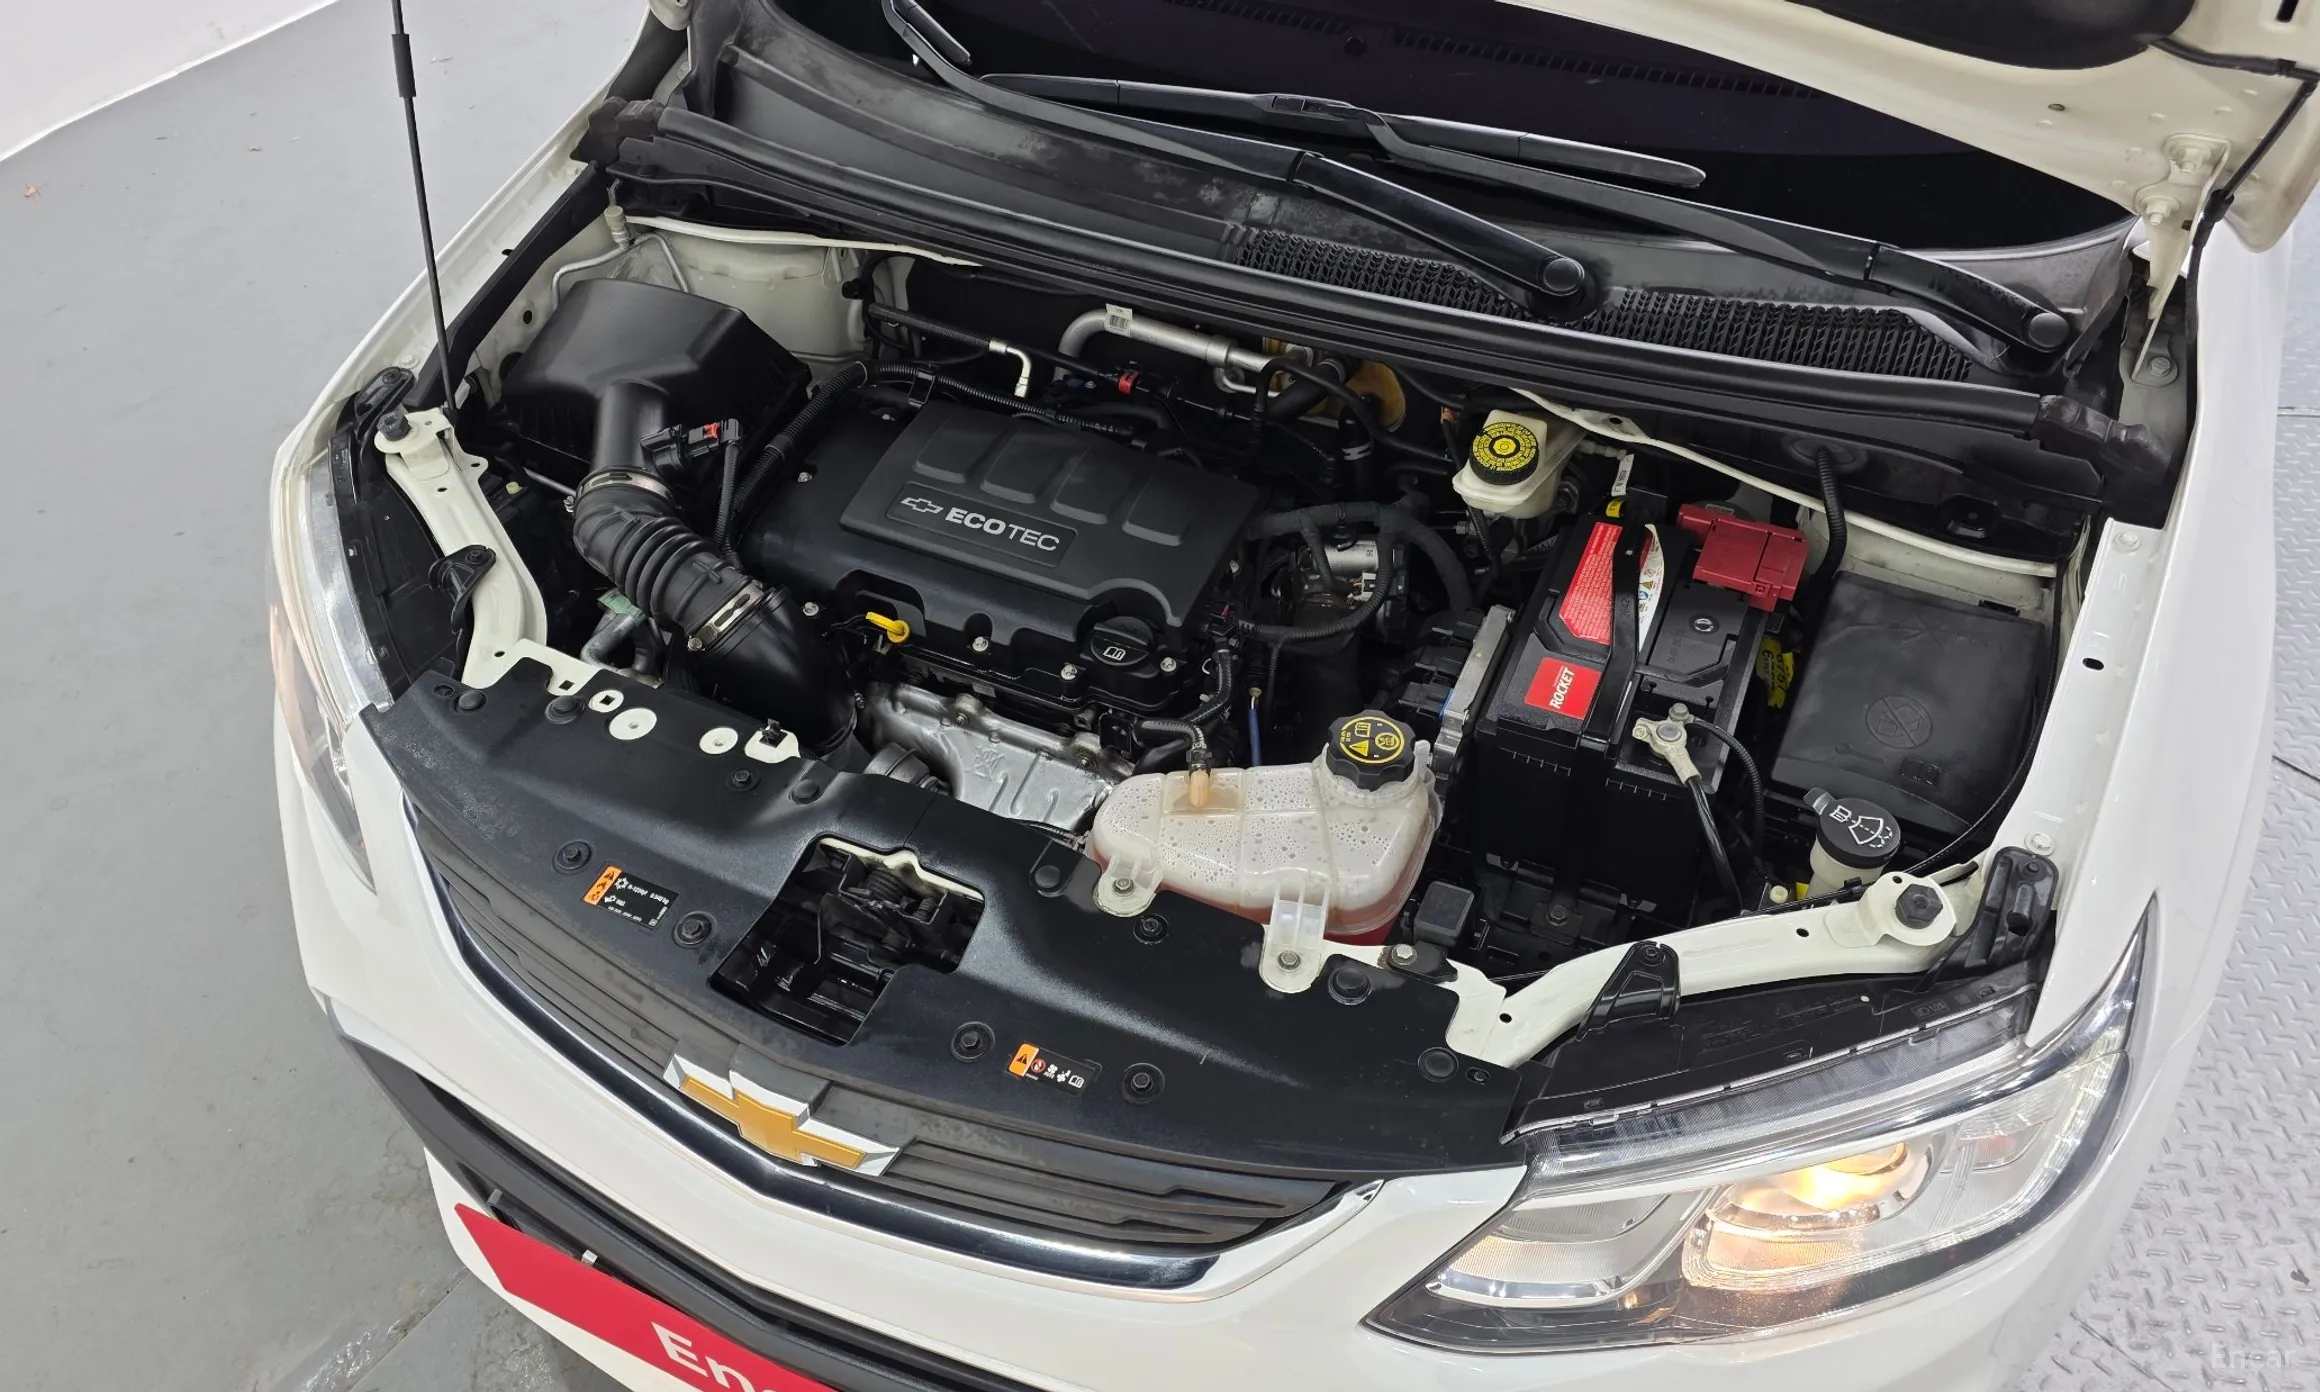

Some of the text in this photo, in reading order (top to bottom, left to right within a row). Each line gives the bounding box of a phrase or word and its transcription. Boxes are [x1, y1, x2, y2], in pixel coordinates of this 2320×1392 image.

[945, 507, 1060, 551] ECOTEC
[1549, 666, 1575, 710] ROCKET
[651, 1321, 778, 1392] En
